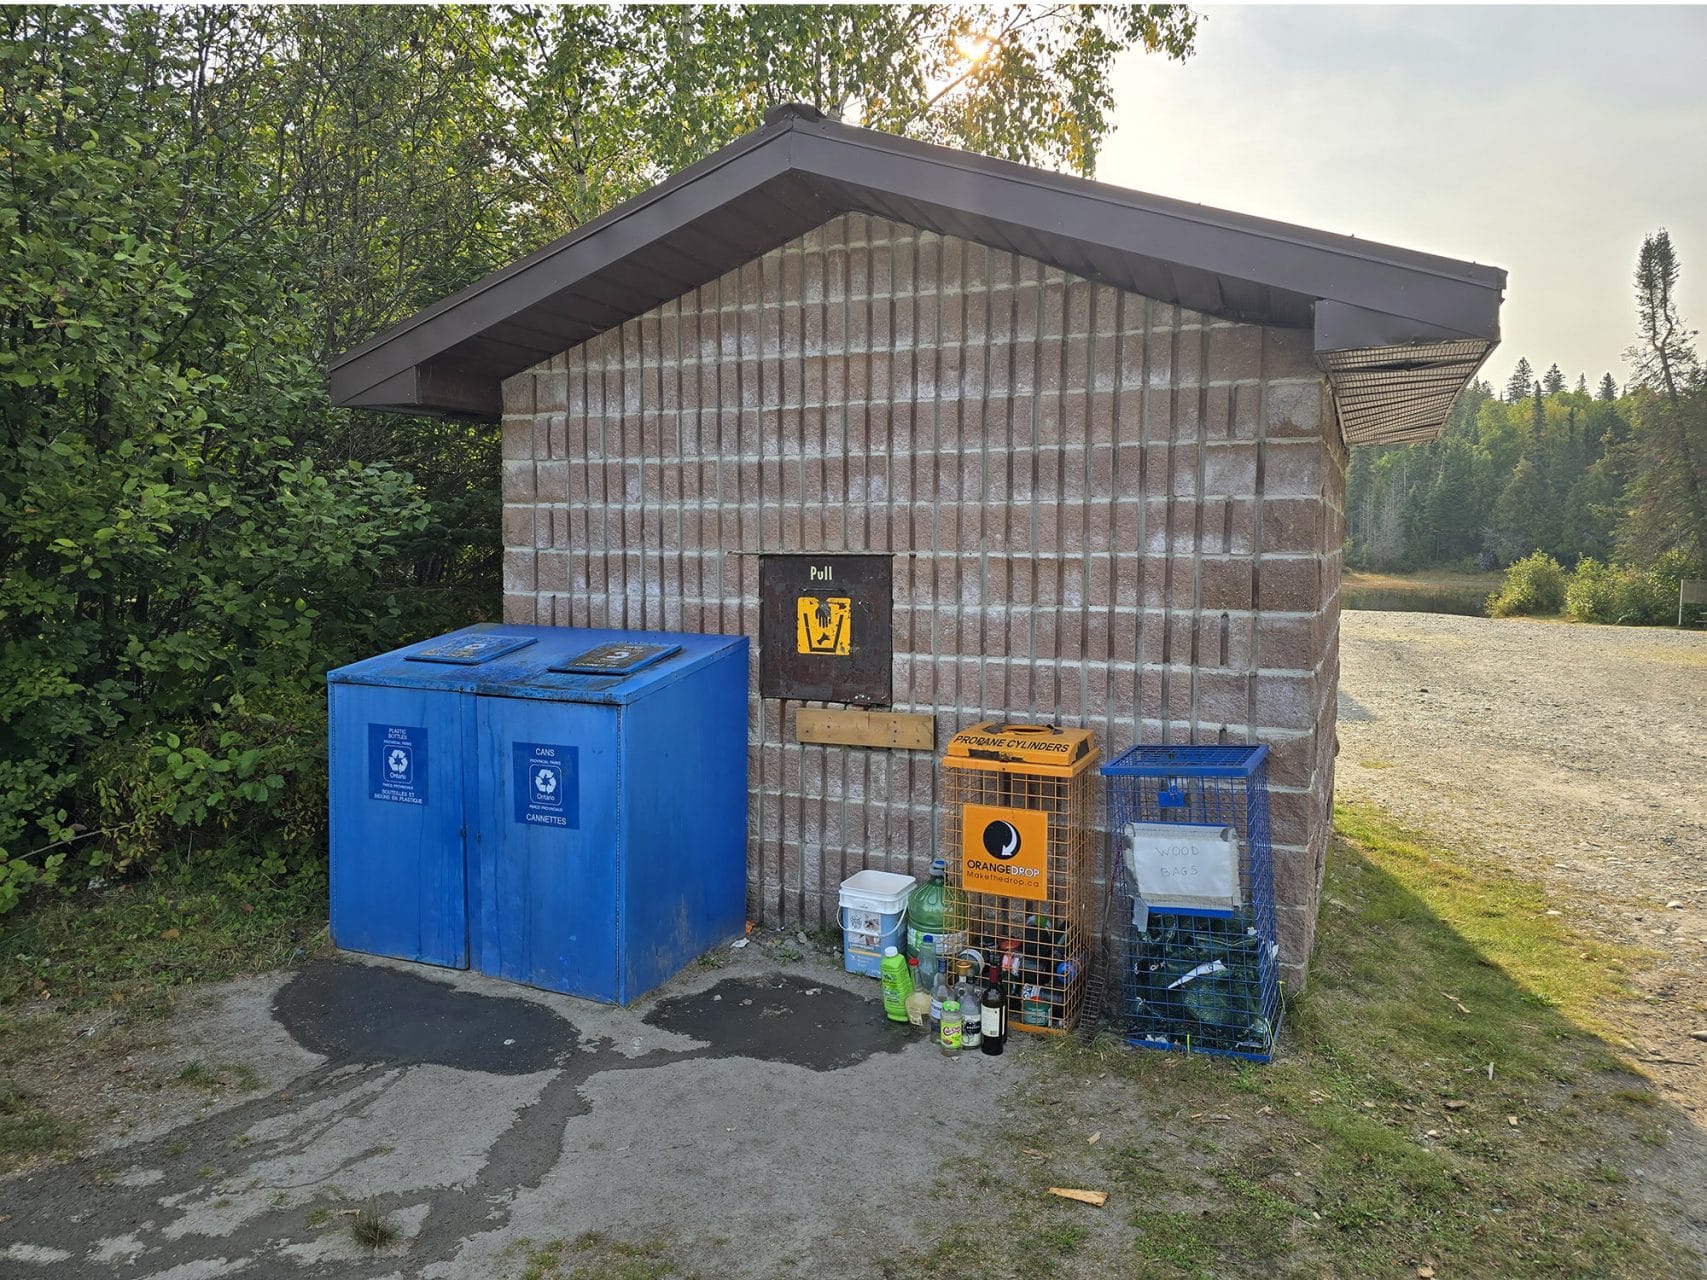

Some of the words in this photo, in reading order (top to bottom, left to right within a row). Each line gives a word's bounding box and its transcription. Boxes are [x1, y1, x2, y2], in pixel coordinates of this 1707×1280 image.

[810, 566, 833, 580] Pull
[1007, 740, 1070, 752] CYLINDERS
[536, 748, 555, 756] CANS
[526, 814, 567, 825] CANNETTES
[1154, 846, 1200, 856] WOOD
[1160, 866, 1200, 877] BAGS
[966, 871, 1040, 887] Makethedrop.ca
